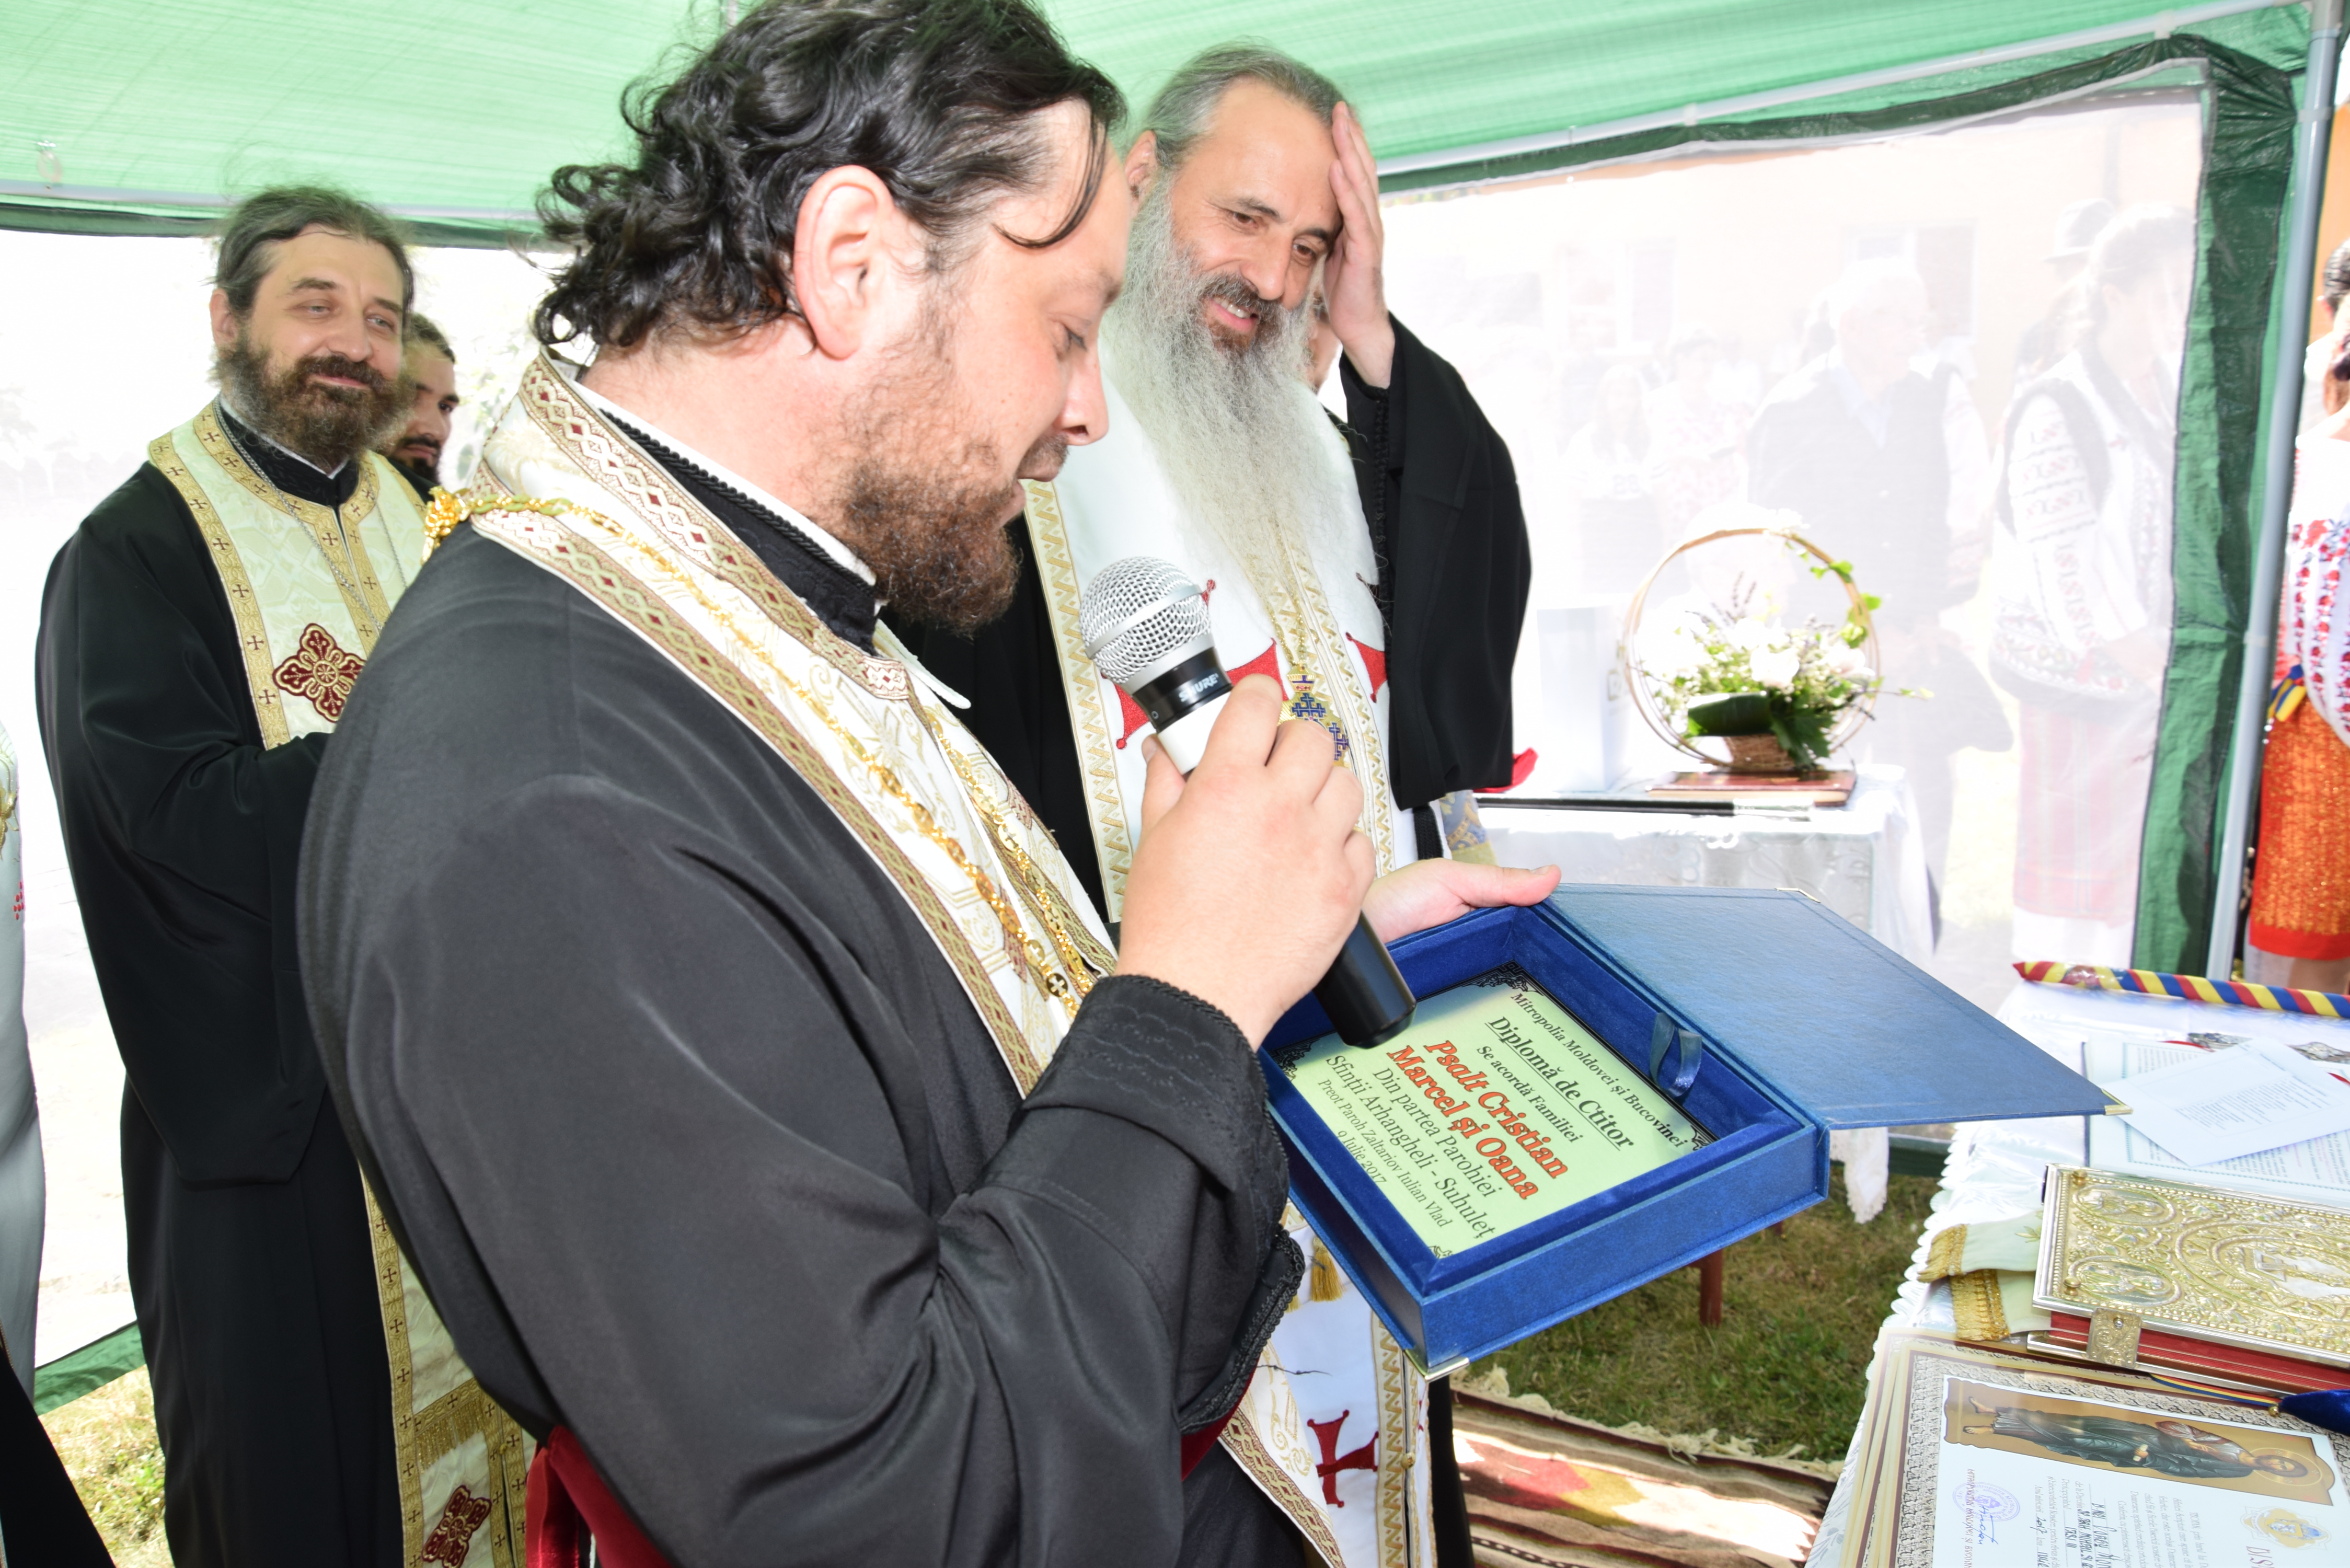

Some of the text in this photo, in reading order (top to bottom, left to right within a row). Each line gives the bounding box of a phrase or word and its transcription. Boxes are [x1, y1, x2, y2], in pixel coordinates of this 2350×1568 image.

[1179, 673, 1218, 702] SHURE
[1423, 1040, 1569, 1180] Psalt Cristian
[1476, 1046, 1584, 1143] Se acordă Familiei
[1488, 1016, 1634, 1147] Diplomă de Ctitor
[1510, 993, 1566, 1042] Mitropolia
[1562, 1040, 1619, 1086] Moldovei
[1622, 1094, 1688, 1148] Bucovinei
[1318, 1079, 1453, 1227] Preot Paroh Zaltariov Iulian Vlad
[1342, 1136, 1366, 1160] Iulie
[1361, 1160, 1388, 1183] 2017
[1359, 1097, 1438, 1169] Arhangheli
[1372, 1067, 1503, 1197] Din partea Parohiei
[1386, 1045, 1471, 1118] Marcel
[1476, 1137, 1539, 1201] Oana
[2151, 1545, 2161, 1562] noastre
[2162, 1521, 2171, 1531] este
[2178, 1542, 2189, 1557] spune
[2190, 1531, 2202, 1540] prin
